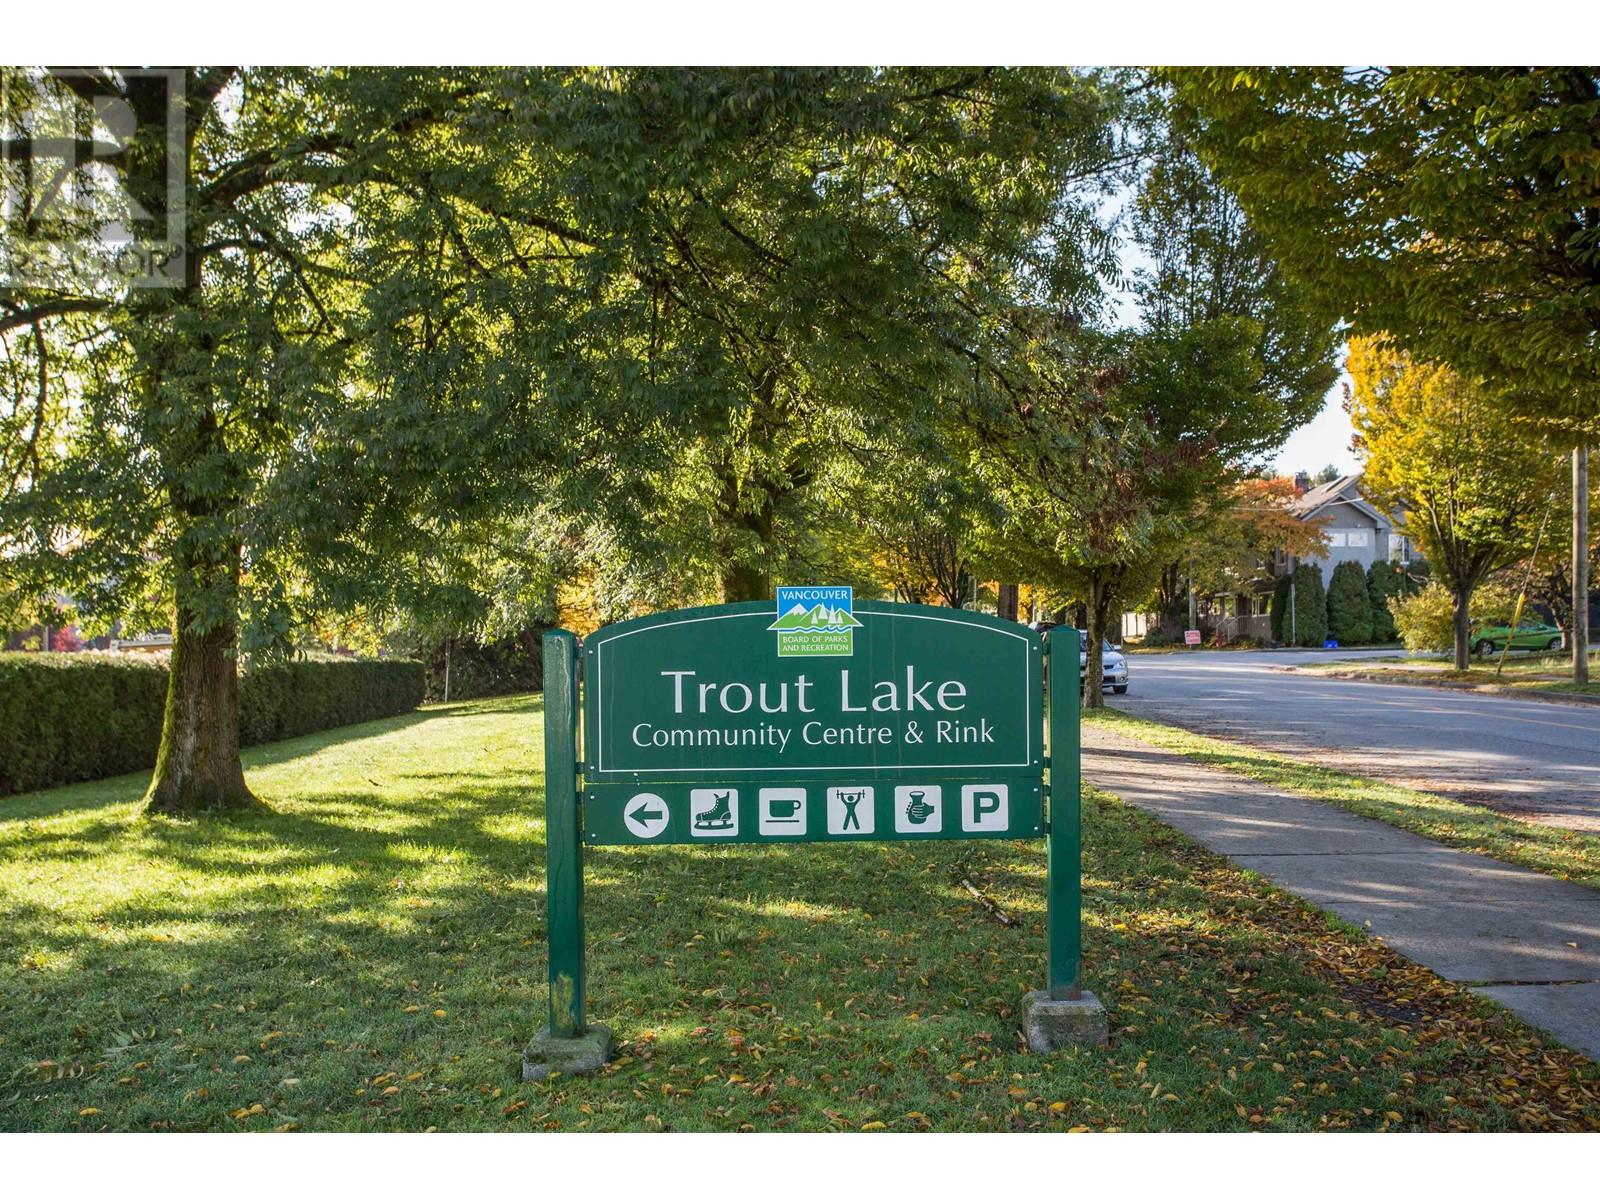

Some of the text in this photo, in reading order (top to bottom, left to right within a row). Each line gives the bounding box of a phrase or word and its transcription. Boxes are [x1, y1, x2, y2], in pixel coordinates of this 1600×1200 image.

[782, 590, 848, 600] VANCOUVER
[783, 635, 848, 643] BOARD OF PARKS
[801, 643, 848, 651] RECREATION
[661, 665, 967, 713] Trout Lake
[632, 718, 995, 754] Community Centre & Rink
[973, 792, 1000, 824] P
